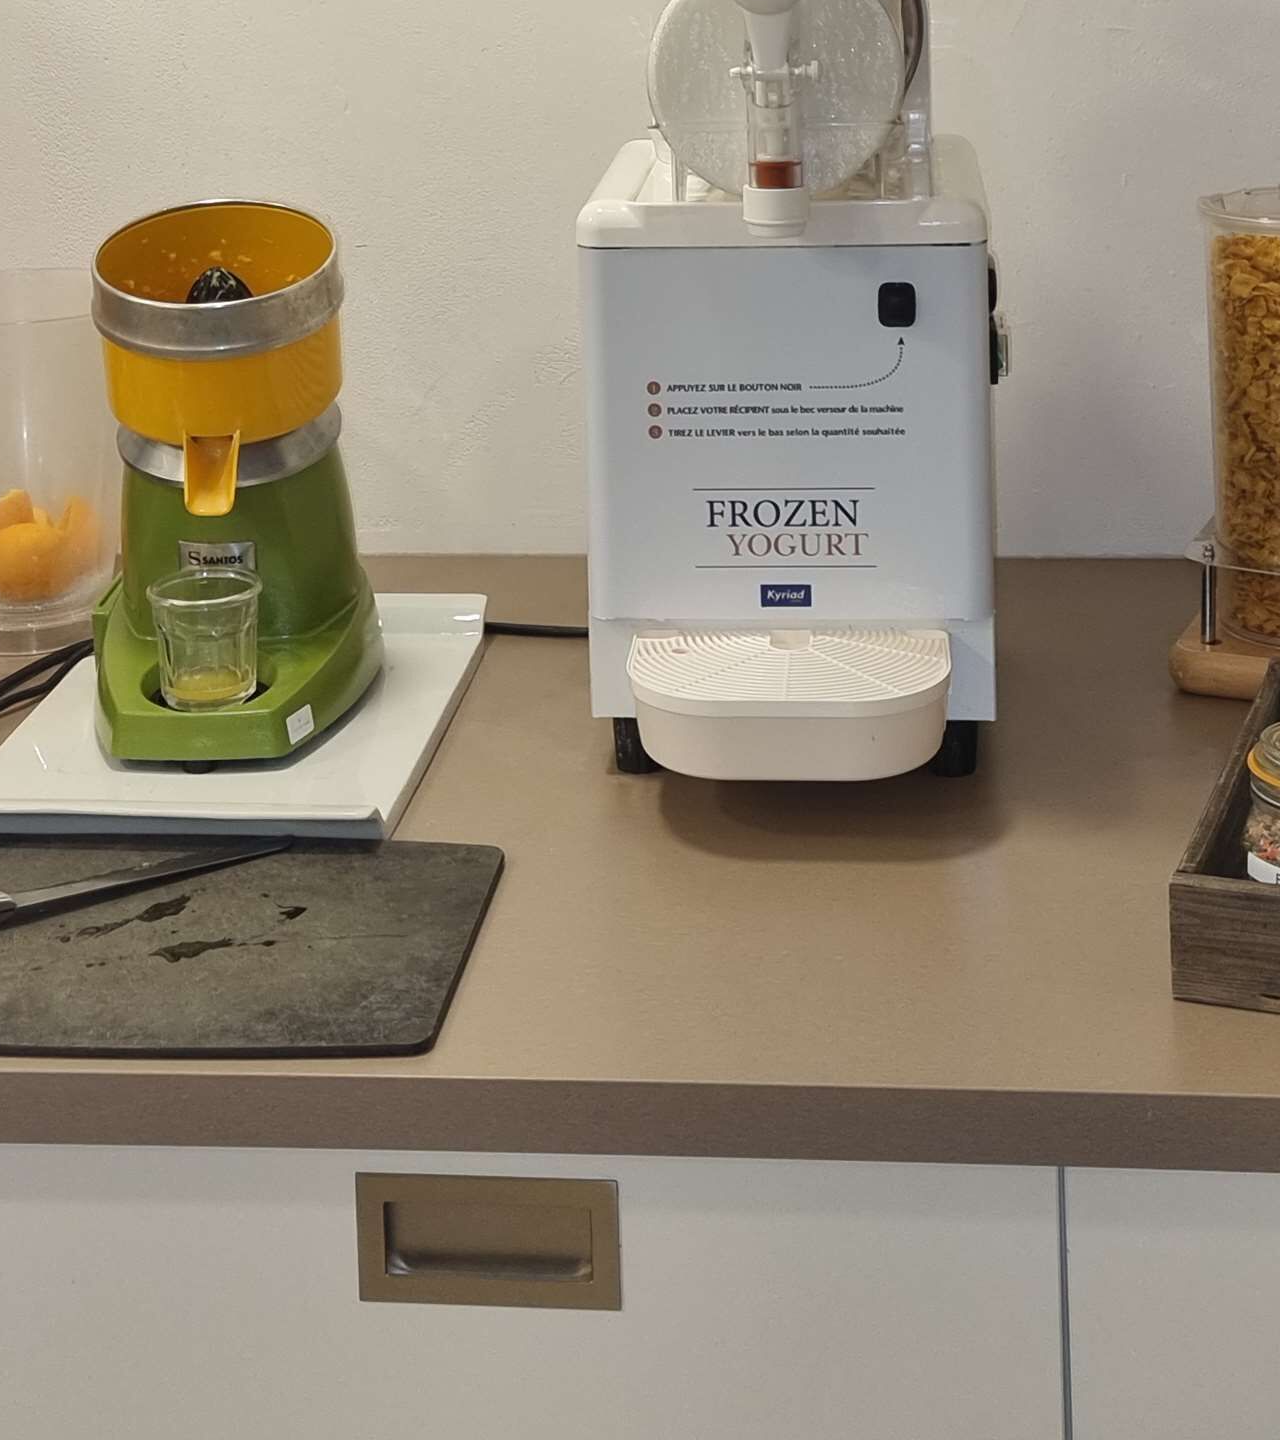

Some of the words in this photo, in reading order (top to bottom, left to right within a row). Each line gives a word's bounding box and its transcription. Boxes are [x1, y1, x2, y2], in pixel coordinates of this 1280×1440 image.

[666, 384, 706, 393] APPUYEZ
[708, 384, 725, 392] SUR
[727, 384, 737, 392] LE
[739, 383, 778, 392] BOUTON
[780, 383, 802, 392] NOIR
[667, 406, 699, 415] PLACEZ
[700, 406, 728, 415] VOTRE
[790, 405, 799, 414] le
[800, 405, 816, 413] bec
[848, 405, 859, 413] de
[860, 405, 868, 413] la
[869, 405, 904, 413] machine
[668, 429, 693, 437] TIREZ
[695, 429, 705, 437] LE
[706, 428, 735, 437] LEVIER
[758, 428, 767, 436] le
[768, 428, 784, 436] bas
[786, 428, 809, 436] selon
[811, 427, 820, 436] la
[821, 427, 859, 437] quantité
[862, 427, 906, 436] souhaitée
[705, 499, 860, 528] FROZEN
[726, 533, 869, 557] YOGURT
[202, 555, 244, 565] SANTOS
[767, 589, 805, 602] Kyriad
